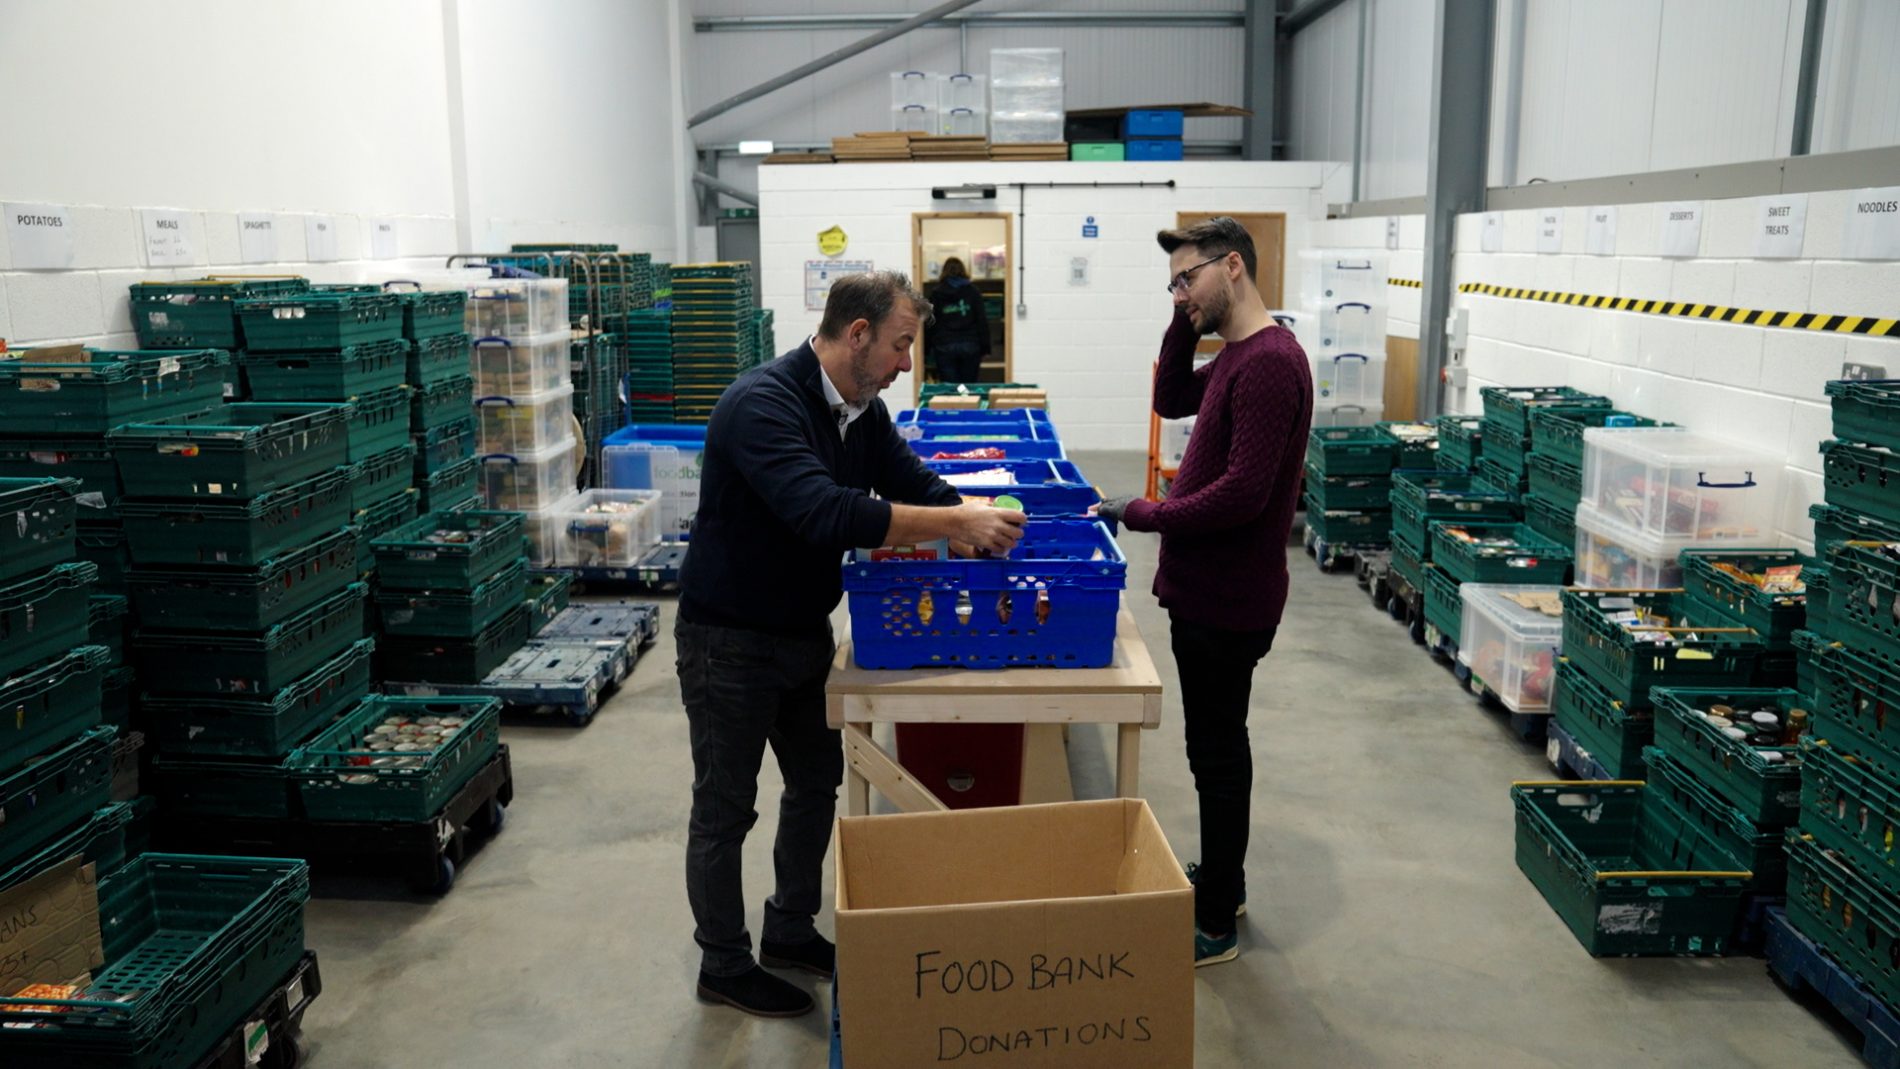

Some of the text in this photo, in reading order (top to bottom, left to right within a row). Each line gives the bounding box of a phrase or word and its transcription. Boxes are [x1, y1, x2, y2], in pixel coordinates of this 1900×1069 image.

[1768, 206, 1791, 217] SWEET
[1857, 201, 1898, 213] NOODLES
[17, 215, 63, 227] POTATOES
[1669, 211, 1694, 221] DESSERTS
[156, 220, 179, 230] MEALS
[1765, 225, 1789, 235] TREATS
[654, 466, 702, 480] foodba
[0, 905, 37, 943] ANS
[915, 950, 1135, 999] FOOD BANK
[937, 1016, 1152, 1062] DONATIONS
